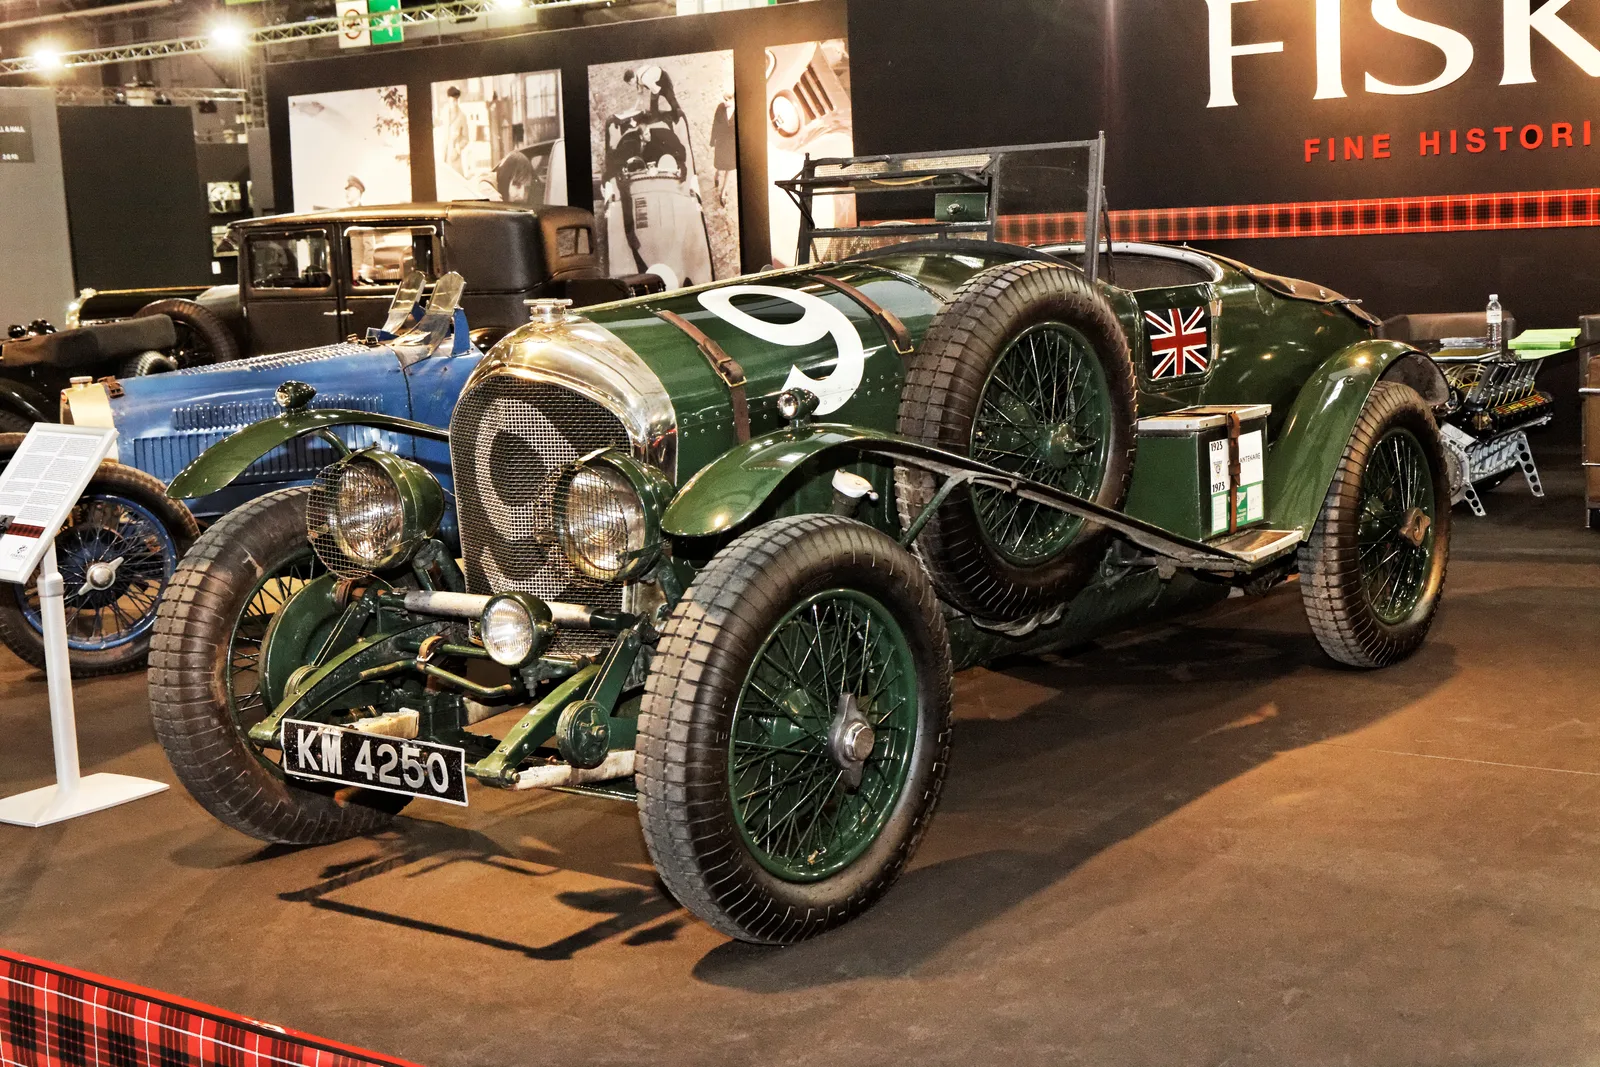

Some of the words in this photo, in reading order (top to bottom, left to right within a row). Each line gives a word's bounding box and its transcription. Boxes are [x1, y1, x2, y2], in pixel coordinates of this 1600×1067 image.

[1205, 0, 1600, 108] FISK
[1304, 134, 1391, 163] FINE
[1419, 120, 1592, 157] HISTORI
[697, 285, 864, 416] 9
[298, 728, 343, 775] KM
[354, 740, 449, 793] 4250
